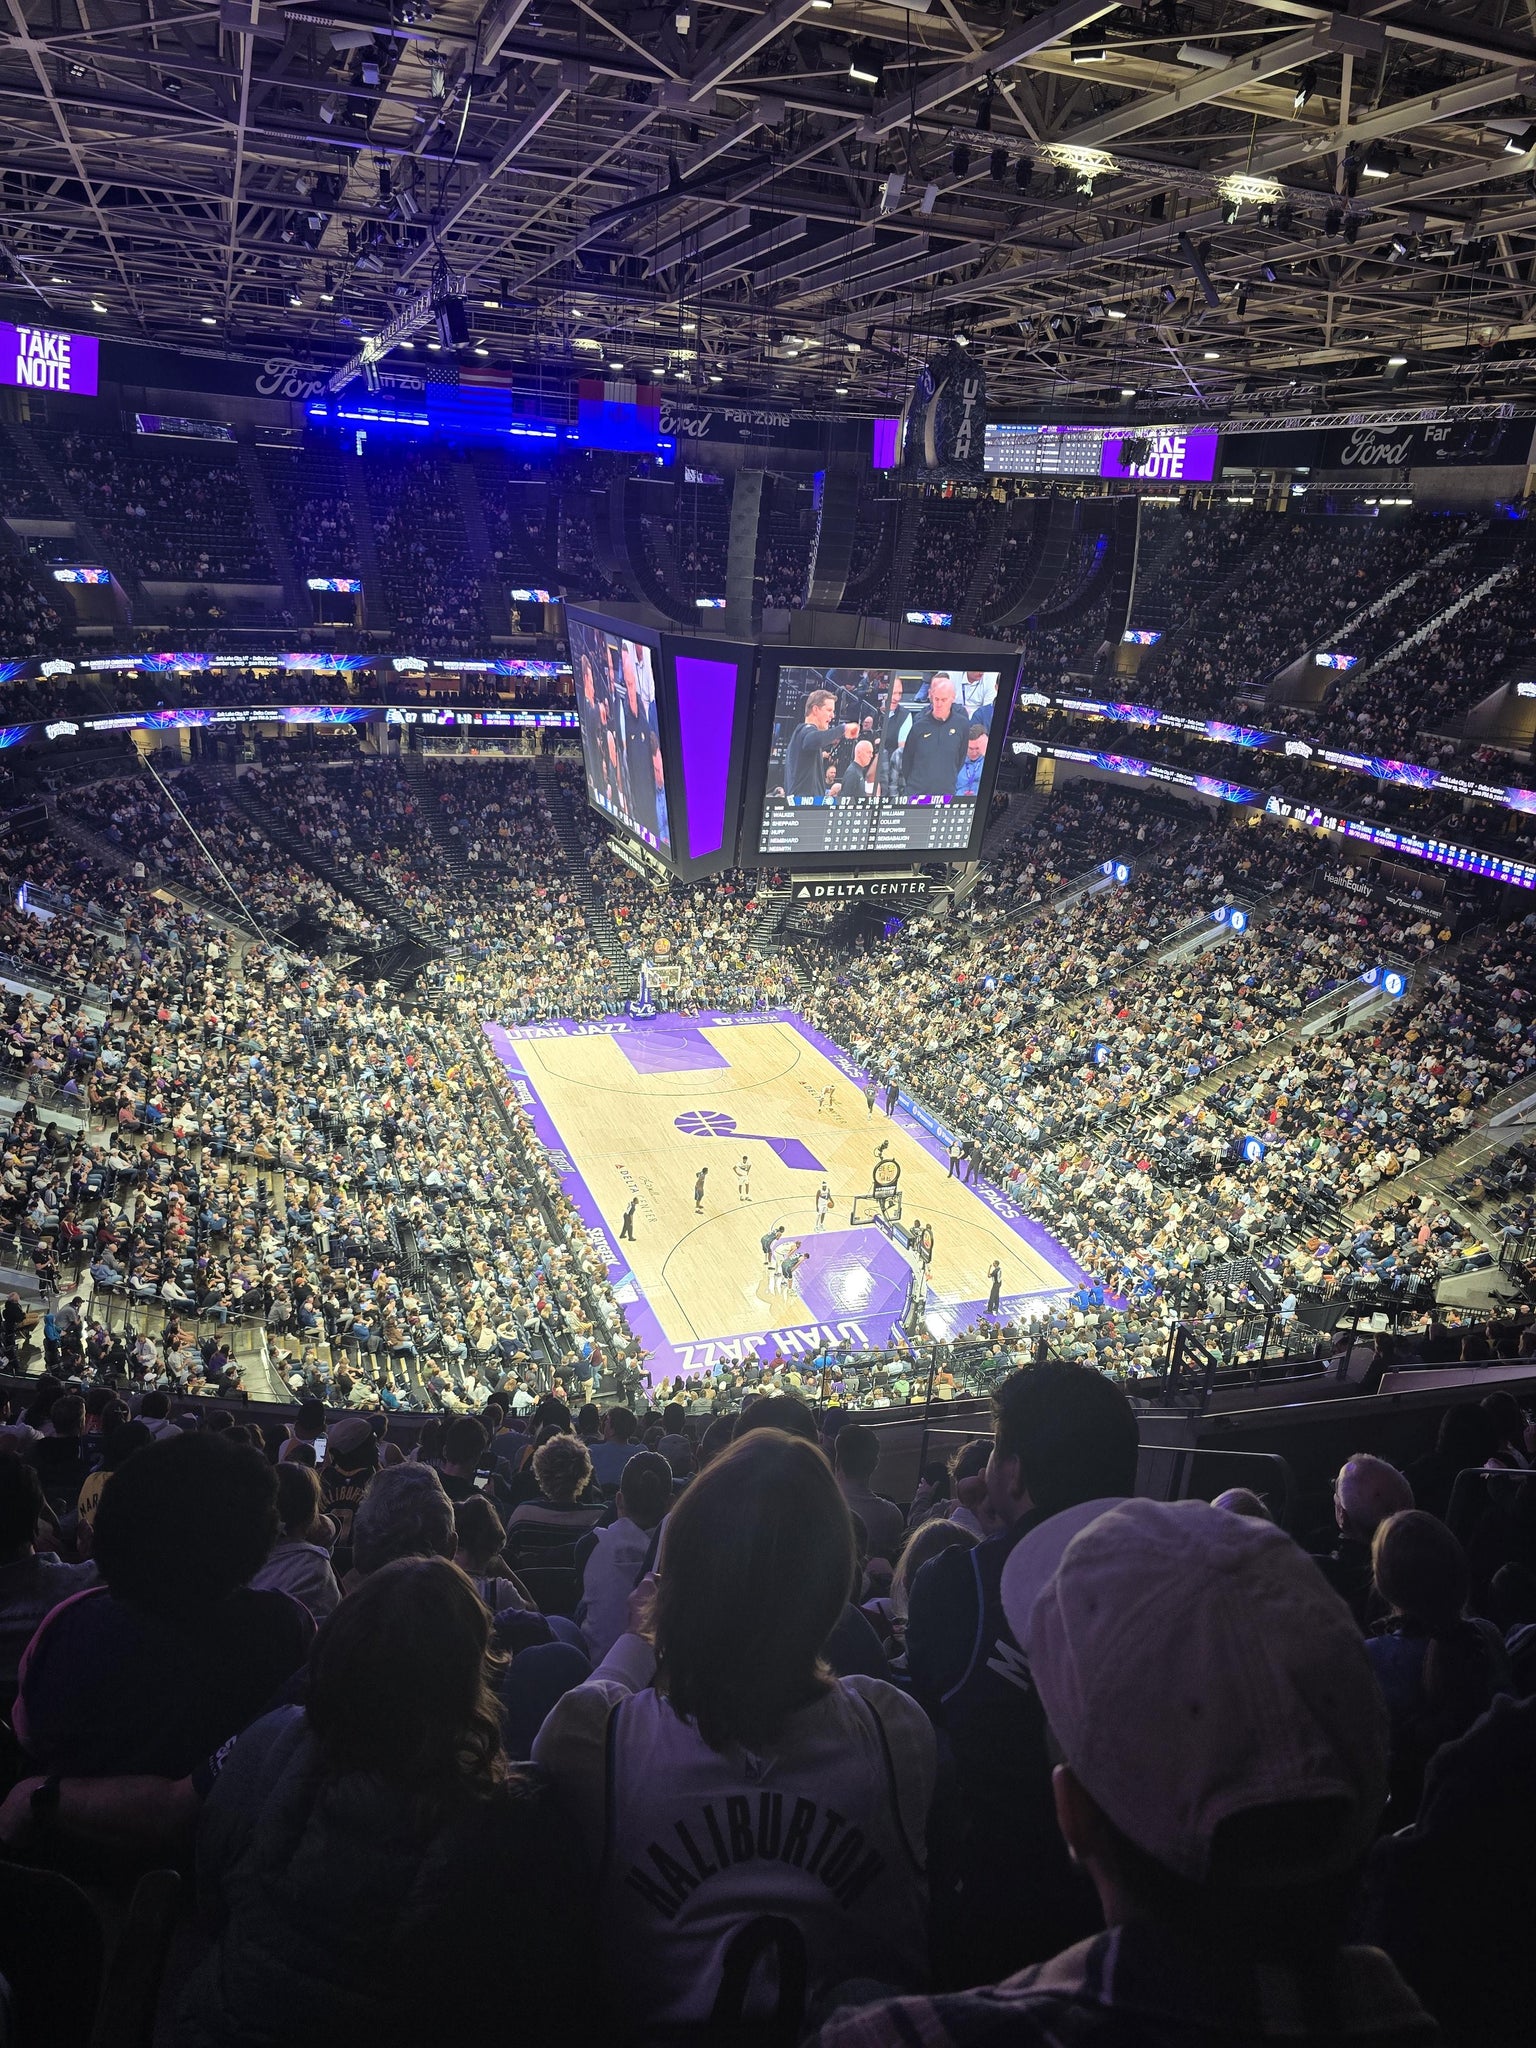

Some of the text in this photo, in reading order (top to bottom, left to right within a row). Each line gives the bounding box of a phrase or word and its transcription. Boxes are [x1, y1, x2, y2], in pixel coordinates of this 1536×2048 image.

[16, 326, 71, 362] TAKE
[16, 356, 71, 391] NOTE
[954, 378, 979, 459] UTAH
[1340, 424, 1414, 466] Ford
[405, 713, 417, 723] 87
[422, 714, 436, 724] 110
[801, 796, 814, 805] IND
[841, 796, 851, 805] 87
[894, 796, 908, 804] 110
[931, 796, 944, 804] UTA
[1489, 787, 1505, 795] Center
[1281, 804, 1291, 816] 87
[1294, 807, 1306, 821] 110
[814, 883, 926, 897] DELTA CENTER
[1324, 871, 1373, 897] HealthEquity
[506, 1022, 631, 1040] UTAH JAZZ
[836, 1056, 863, 1079] PACS
[620, 1169, 639, 1194] DELTA
[638, 1194, 658, 1223] CENTER
[982, 1187, 1020, 1219] PACS
[673, 1320, 869, 1371] UTAH JAZZ
[624, 1791, 888, 1921] HALIBURTON
